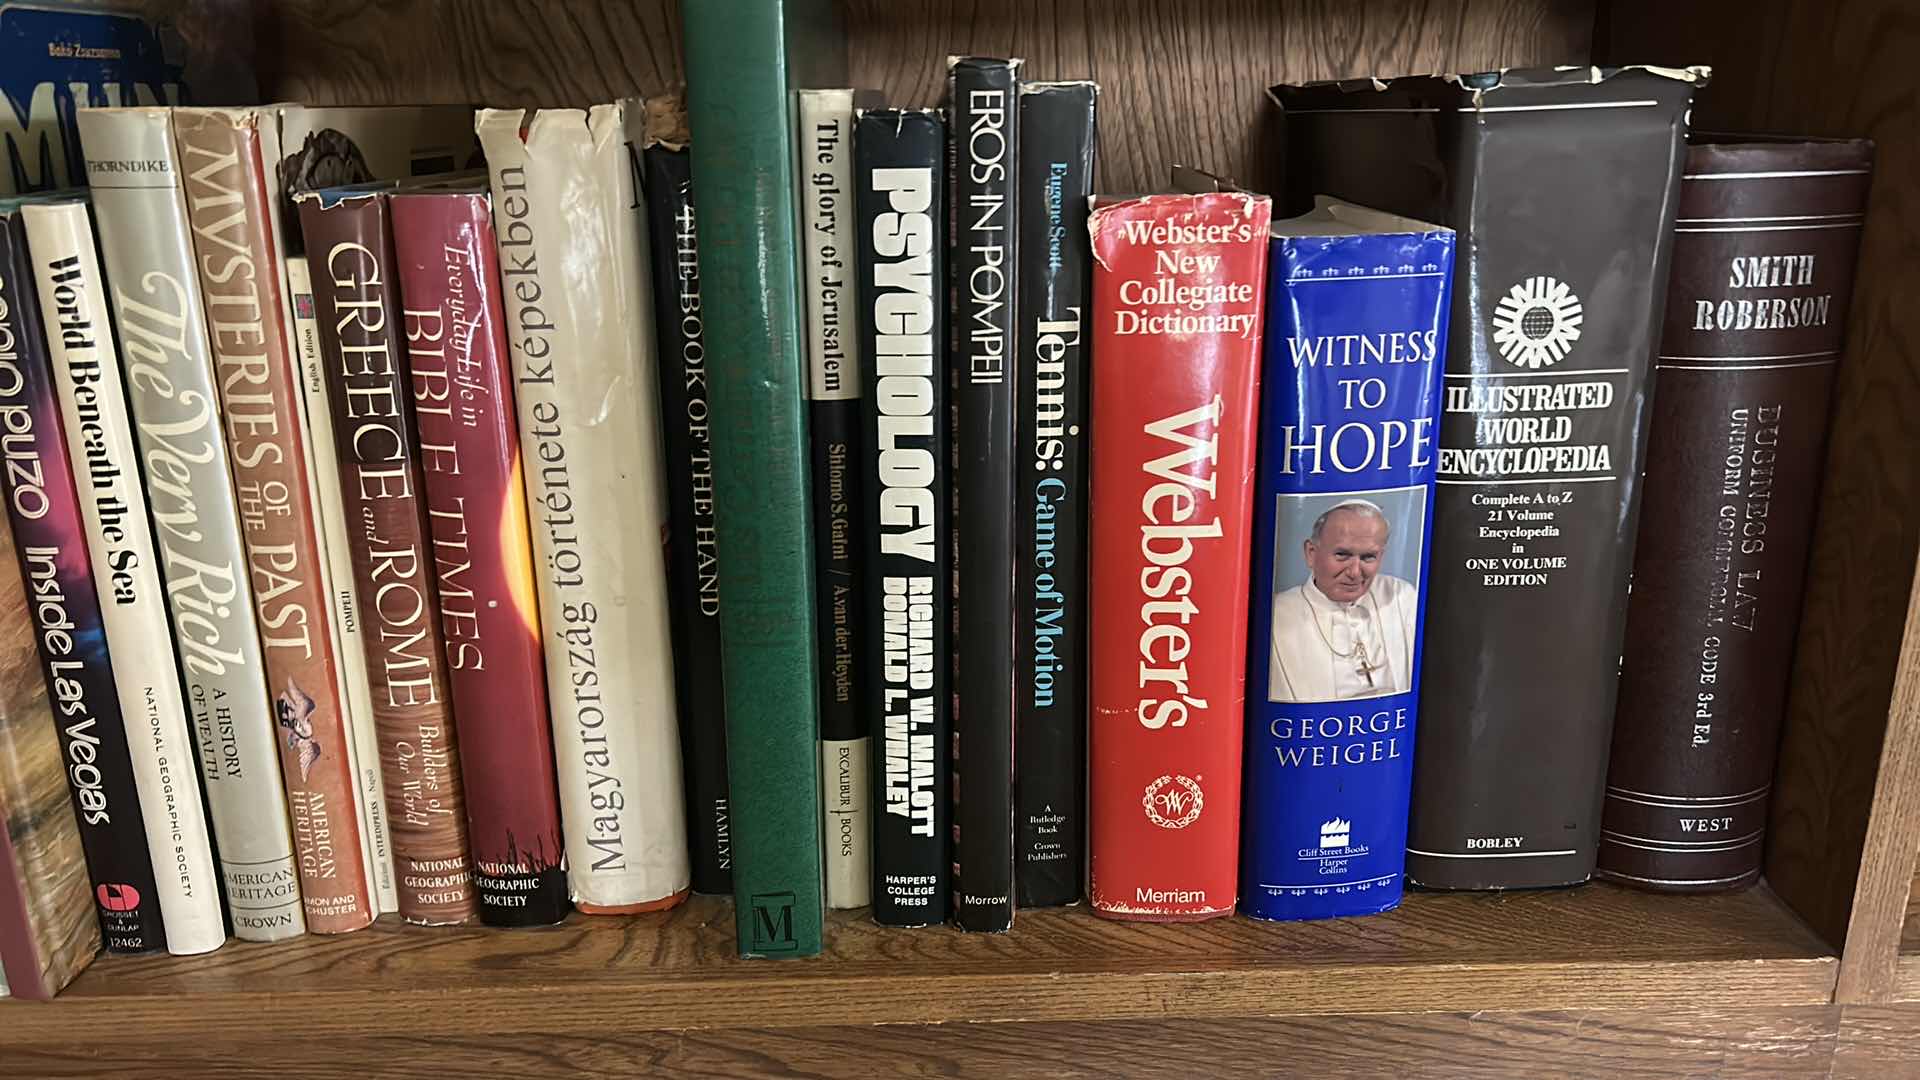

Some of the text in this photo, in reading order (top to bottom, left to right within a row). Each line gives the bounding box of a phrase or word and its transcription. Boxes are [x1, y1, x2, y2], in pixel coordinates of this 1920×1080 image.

[88, 160, 169, 174] THORNDIKE
[1047, 162, 1068, 270] Eugene Scott
[1124, 217, 1252, 246] Webster's
[969, 90, 1006, 384] EROS IN POMPEII
[813, 119, 846, 392] The glory of Jerusalem
[1154, 250, 1221, 275] New
[1729, 255, 1816, 288] SMITH
[1119, 278, 1253, 311] Collegiate
[1114, 309, 1256, 339] Dictionary
[1692, 295, 1831, 330] ROBERSON
[185, 144, 291, 516] MYSTERIES OF
[444, 243, 488, 427] Everyday Life in
[303, 327, 320, 393] English Edition
[872, 168, 935, 562] PSYCHOLOGY
[1286, 329, 1438, 369] WITNESS
[1338, 378, 1387, 410] TO
[1446, 382, 1614, 413] ILLUSTRATED
[676, 206, 720, 616] THE BOOK OF THE HAND
[49, 256, 139, 605] World Beneath the Sea
[1280, 416, 1433, 475] HOPE
[1480, 416, 1572, 445] WORLD
[1436, 445, 1611, 475] ENCYCLOPEDIA
[1723, 408, 1749, 495] UNIFORM
[116, 271, 245, 675] The Very Rich
[327, 242, 440, 707] GREECE and ROME
[828, 443, 847, 500] Shlomo
[403, 305, 486, 671] BIBLE TIMES
[1471, 491, 1573, 508] Complete A to Z
[500, 164, 626, 872] Magyarország története képekben
[1034, 307, 1081, 708] Tennis: Game of Motion
[1487, 510, 1554, 521] 21 Volume
[1479, 526, 1560, 539] Encyclopedia
[1511, 543, 1524, 554] in
[240, 481, 313, 660] THE PAST
[1138, 393, 1225, 729] Webster's
[1465, 557, 1567, 570] ONE VOLUME
[1483, 574, 1548, 586] EDITION
[341, 591, 356, 633] POMPEII
[835, 628, 849, 649] der
[1700, 635, 1721, 684] CODE
[25, 547, 110, 825] Inside Las Vegas
[832, 652, 850, 702] Heyden
[883, 577, 909, 817] DONALD L. WHALEY
[909, 577, 935, 837] RICHARD W. MALOTT
[1695, 692, 1714, 718] 3rd
[192, 684, 220, 780] OF WEALTH
[213, 688, 242, 778] A HISTORY
[1270, 708, 1407, 740] GEORGE
[1275, 738, 1400, 767] WEIGEL
[396, 741, 429, 826] Our World
[419, 725, 453, 816] Builders of
[144, 687, 193, 898] NATIONAL GEOGRAPHIC SOCIETY
[839, 747, 852, 857] EXCALIBUR BOOKS
[1044, 804, 1051, 812] A
[292, 792, 318, 879] HERITAGE
[309, 792, 337, 879] AMERICAN
[371, 801, 385, 857] INTERDIPRESS
[715, 798, 731, 870] HAMLYN
[1030, 815, 1066, 824] Rutledge
[1038, 825, 1058, 834] Book
[1679, 817, 1733, 832] WEST
[1027, 852, 1067, 861] Publishers
[1034, 842, 1061, 850] Crown
[1298, 844, 1369, 858] Cliff Street Books
[1466, 837, 1523, 848] BOBLEY
[411, 857, 464, 872] NATIONAL
[478, 861, 530, 874] NATIONAL
[886, 874, 936, 885] HARPER'S
[1319, 858, 1348, 869] Harper
[1319, 866, 1348, 875] Collins
[333, 894, 356, 905] AND
[418, 890, 464, 904] SOCIETY
[483, 893, 527, 907] SOCIETY
[887, 885, 935, 896] COLLEGE
[894, 896, 929, 906] PRESS
[965, 893, 1008, 906] Morrow
[1136, 887, 1205, 903] Merriam
[235, 912, 292, 928] CROWN
[110, 937, 142, 948] 12462
